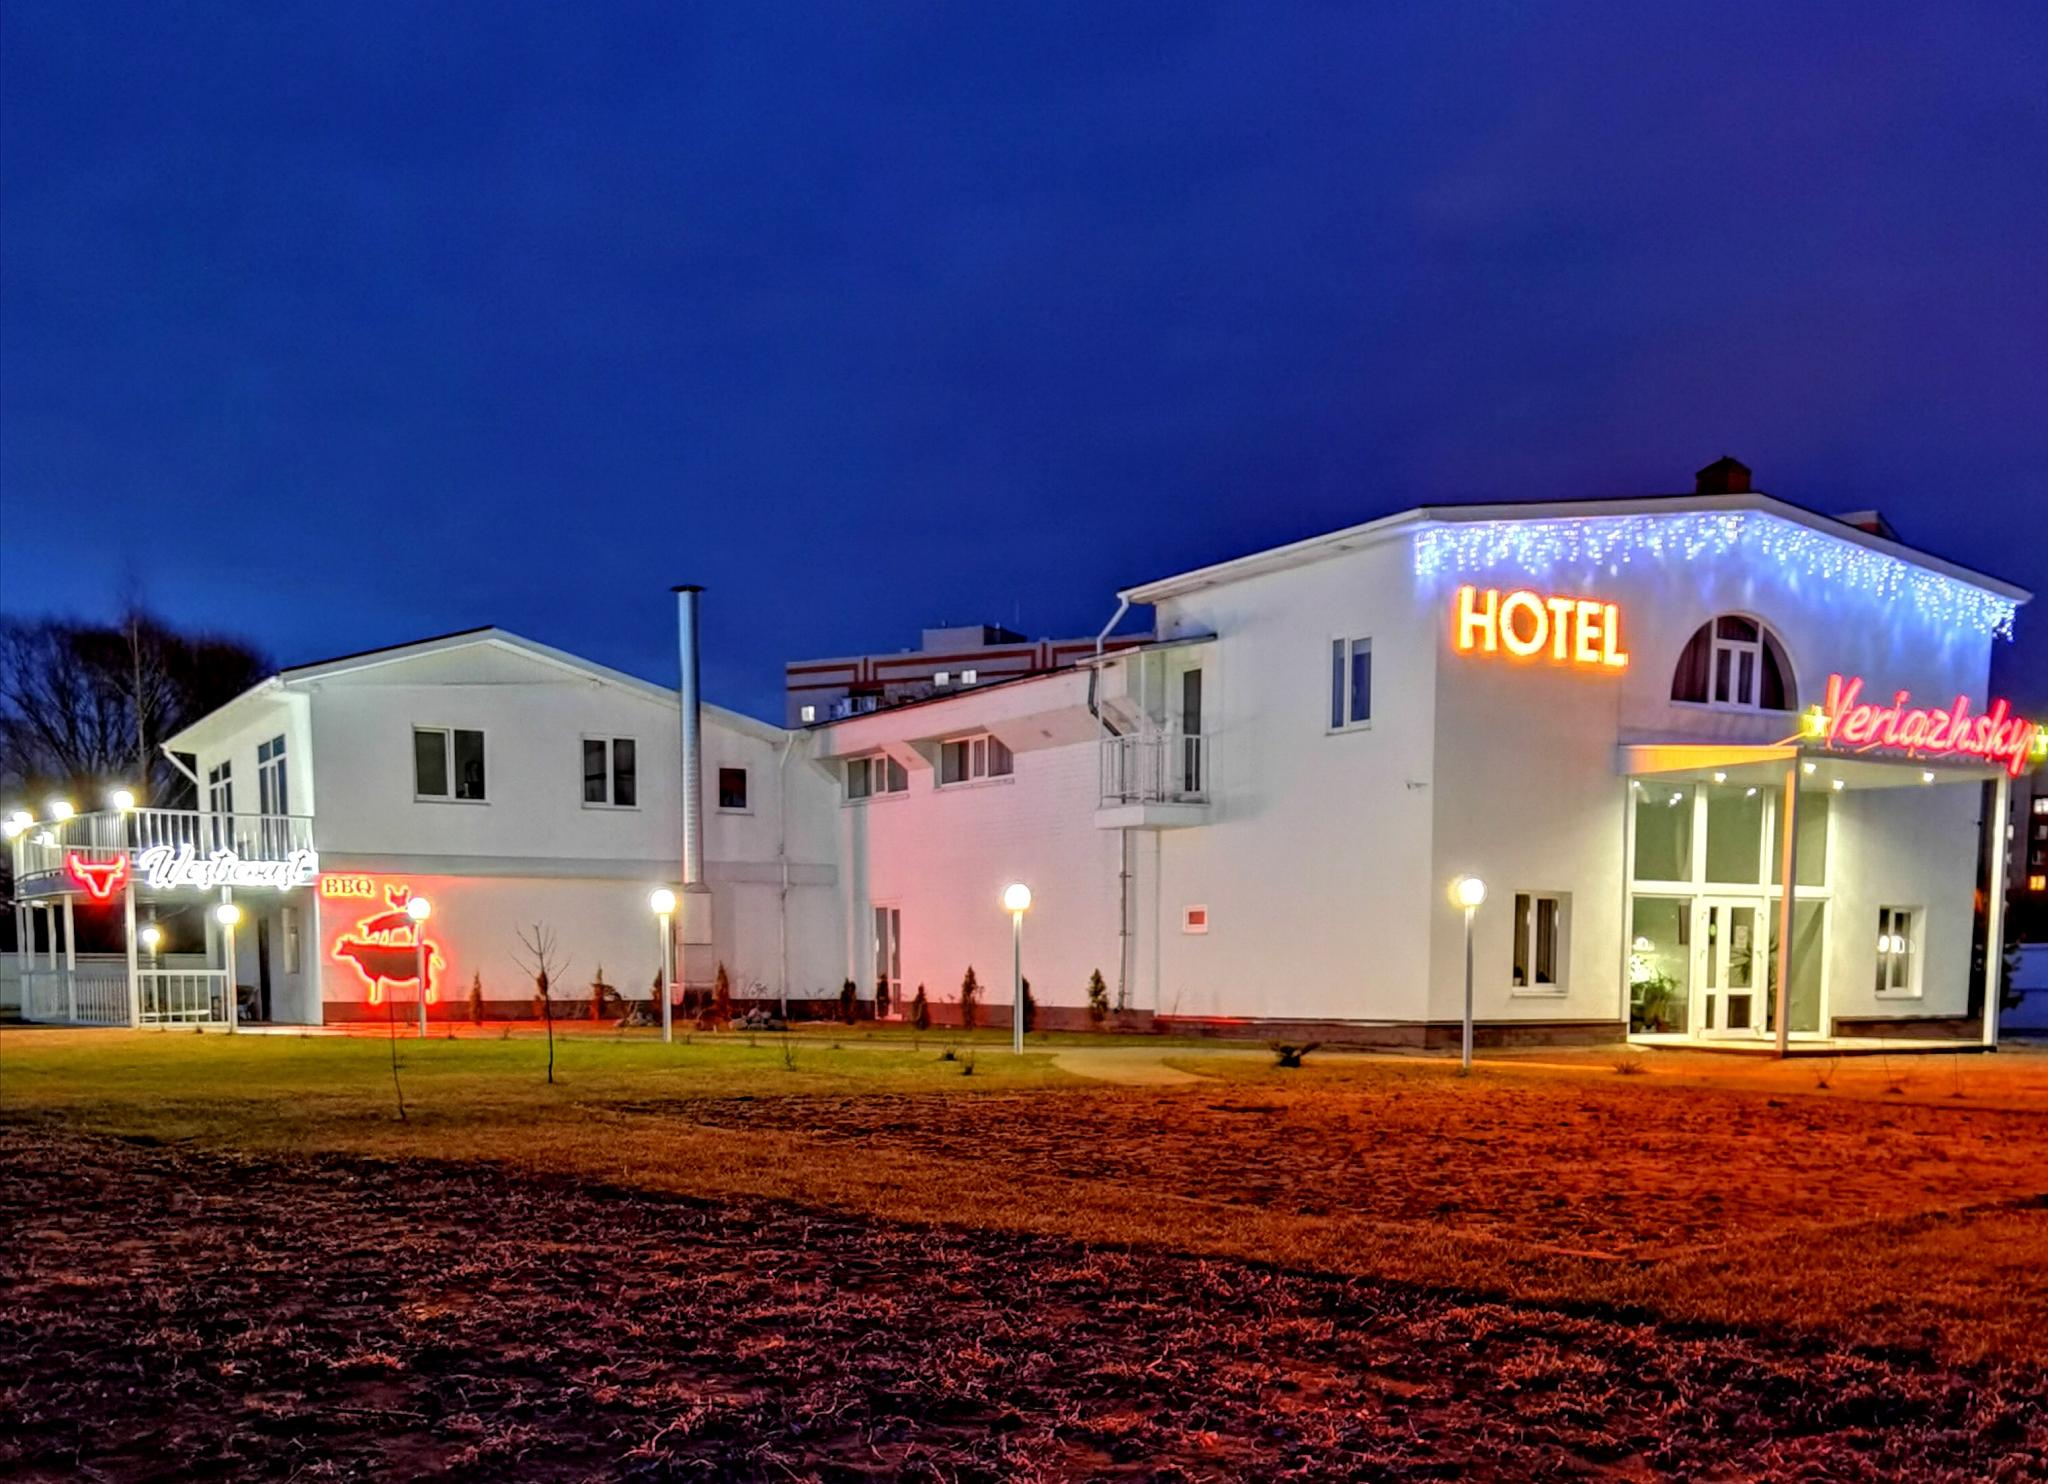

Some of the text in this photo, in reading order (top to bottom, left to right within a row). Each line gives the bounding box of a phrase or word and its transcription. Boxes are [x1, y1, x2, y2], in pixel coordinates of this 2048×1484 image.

[1457, 584, 1629, 668] HOTEL
[1825, 673, 2036, 776] Veriazhsky
[324, 878, 374, 895] BBQ
